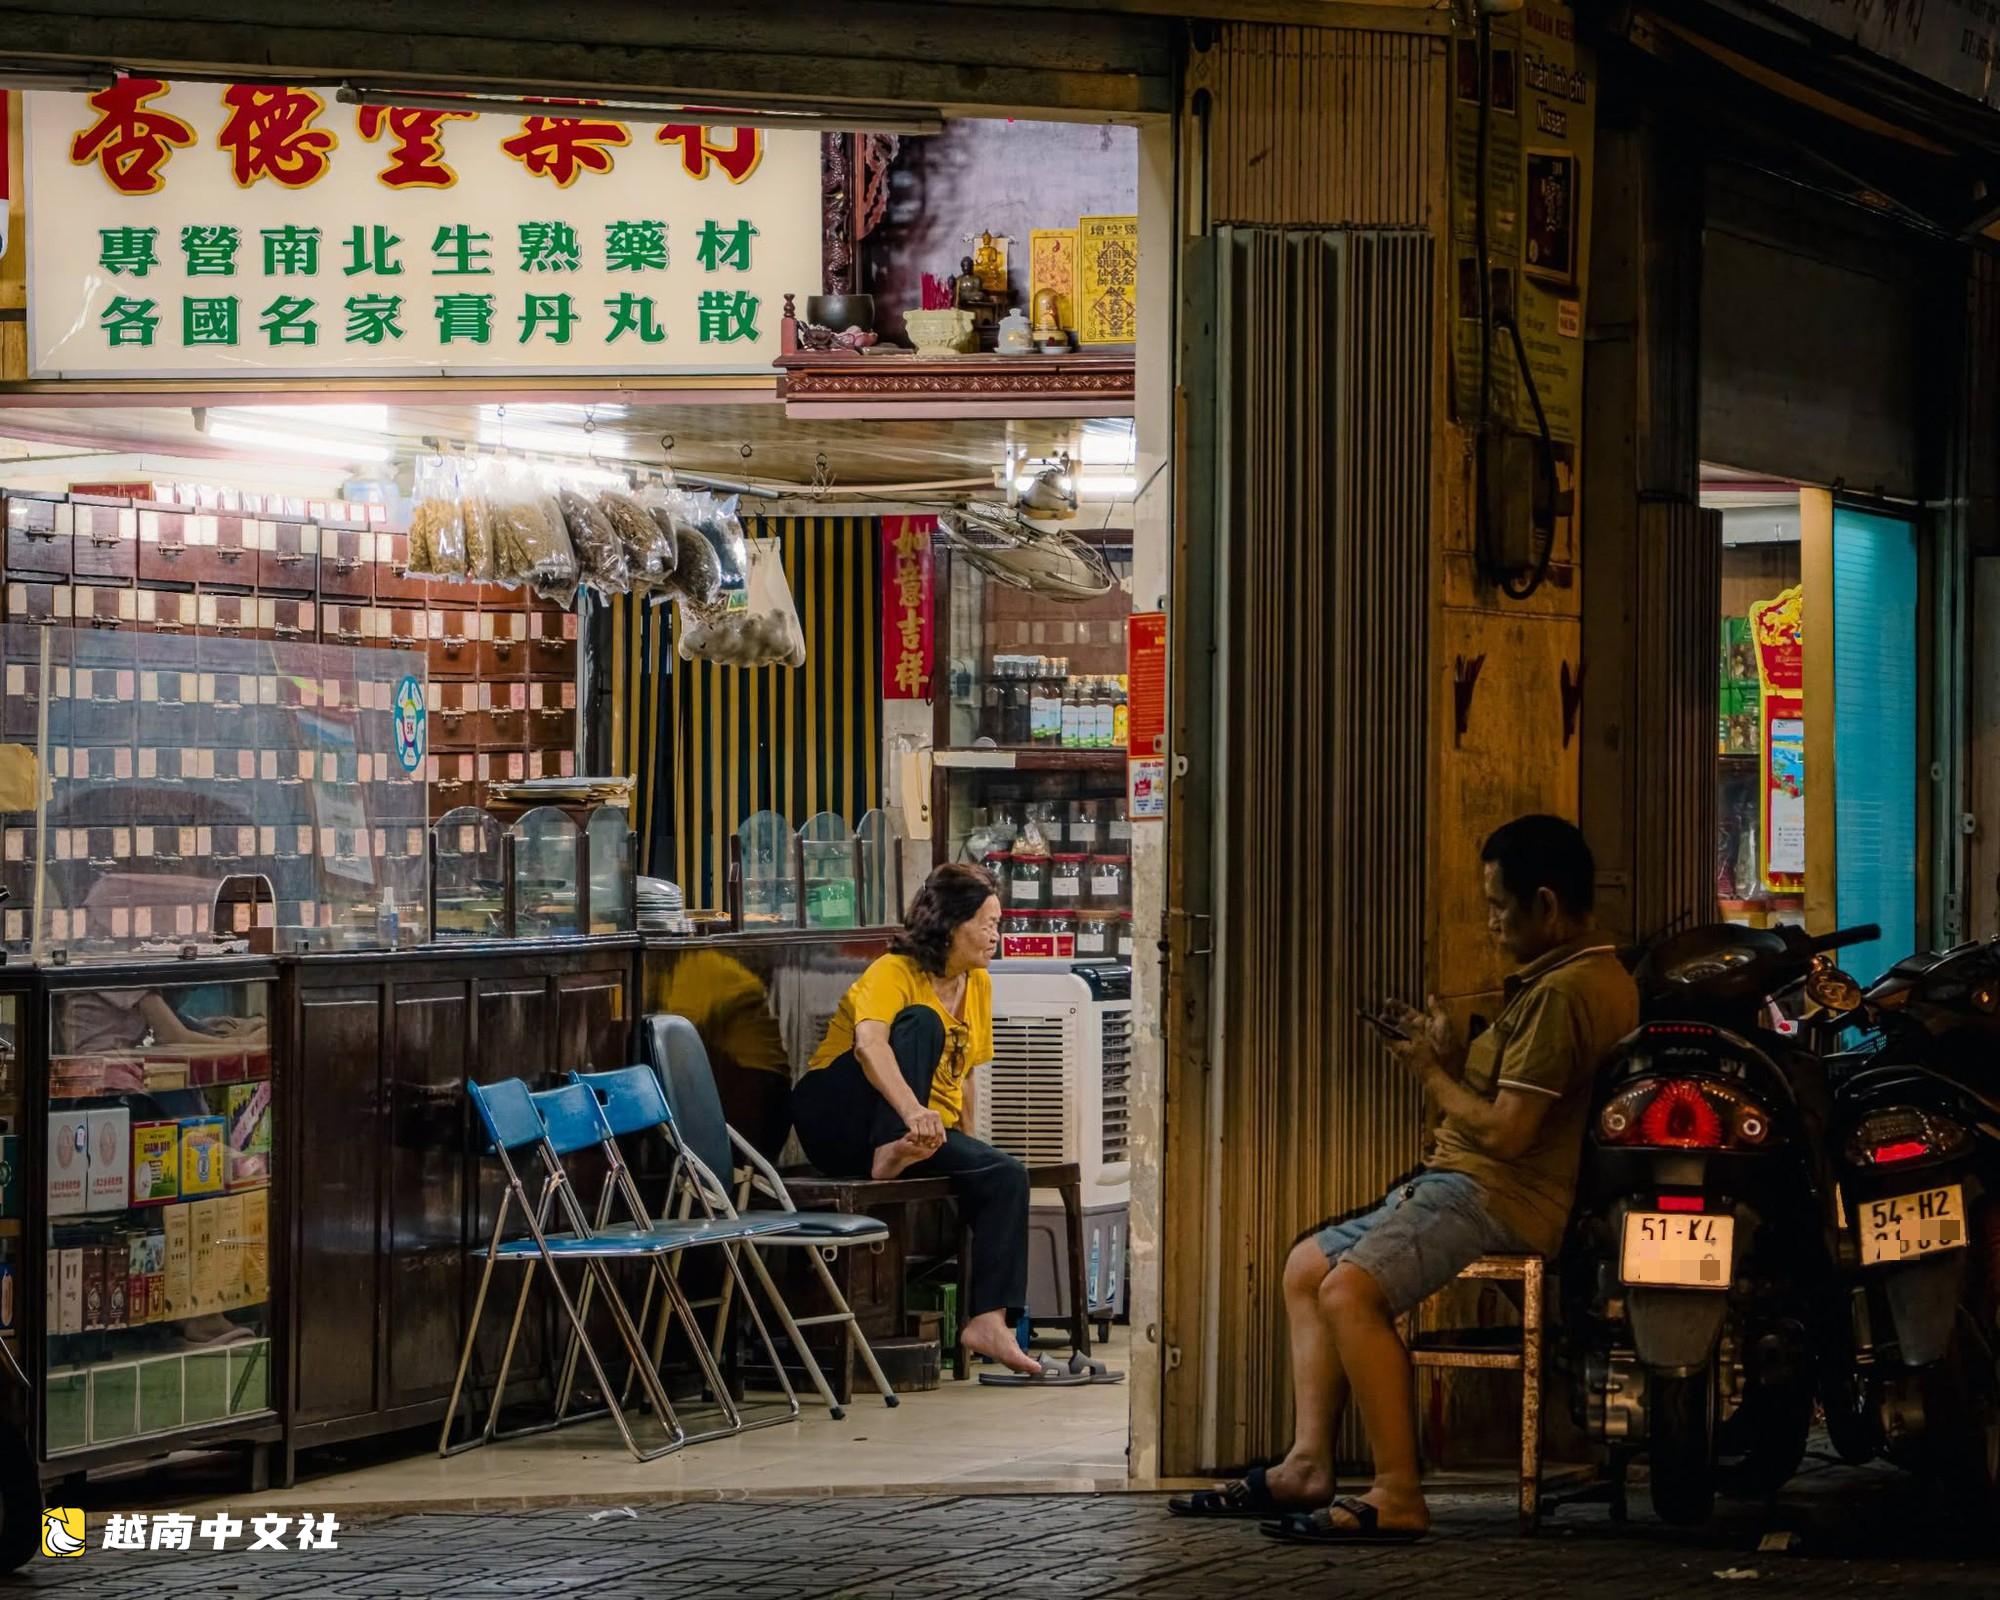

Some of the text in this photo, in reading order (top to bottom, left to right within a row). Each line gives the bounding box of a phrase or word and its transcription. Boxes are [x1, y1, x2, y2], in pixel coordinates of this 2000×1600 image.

[97, 218, 760, 277] 專營南北生熟藥材
[99, 289, 761, 346] 各國名家膏丹丸散
[892, 516, 930, 699] 如意吉祥
